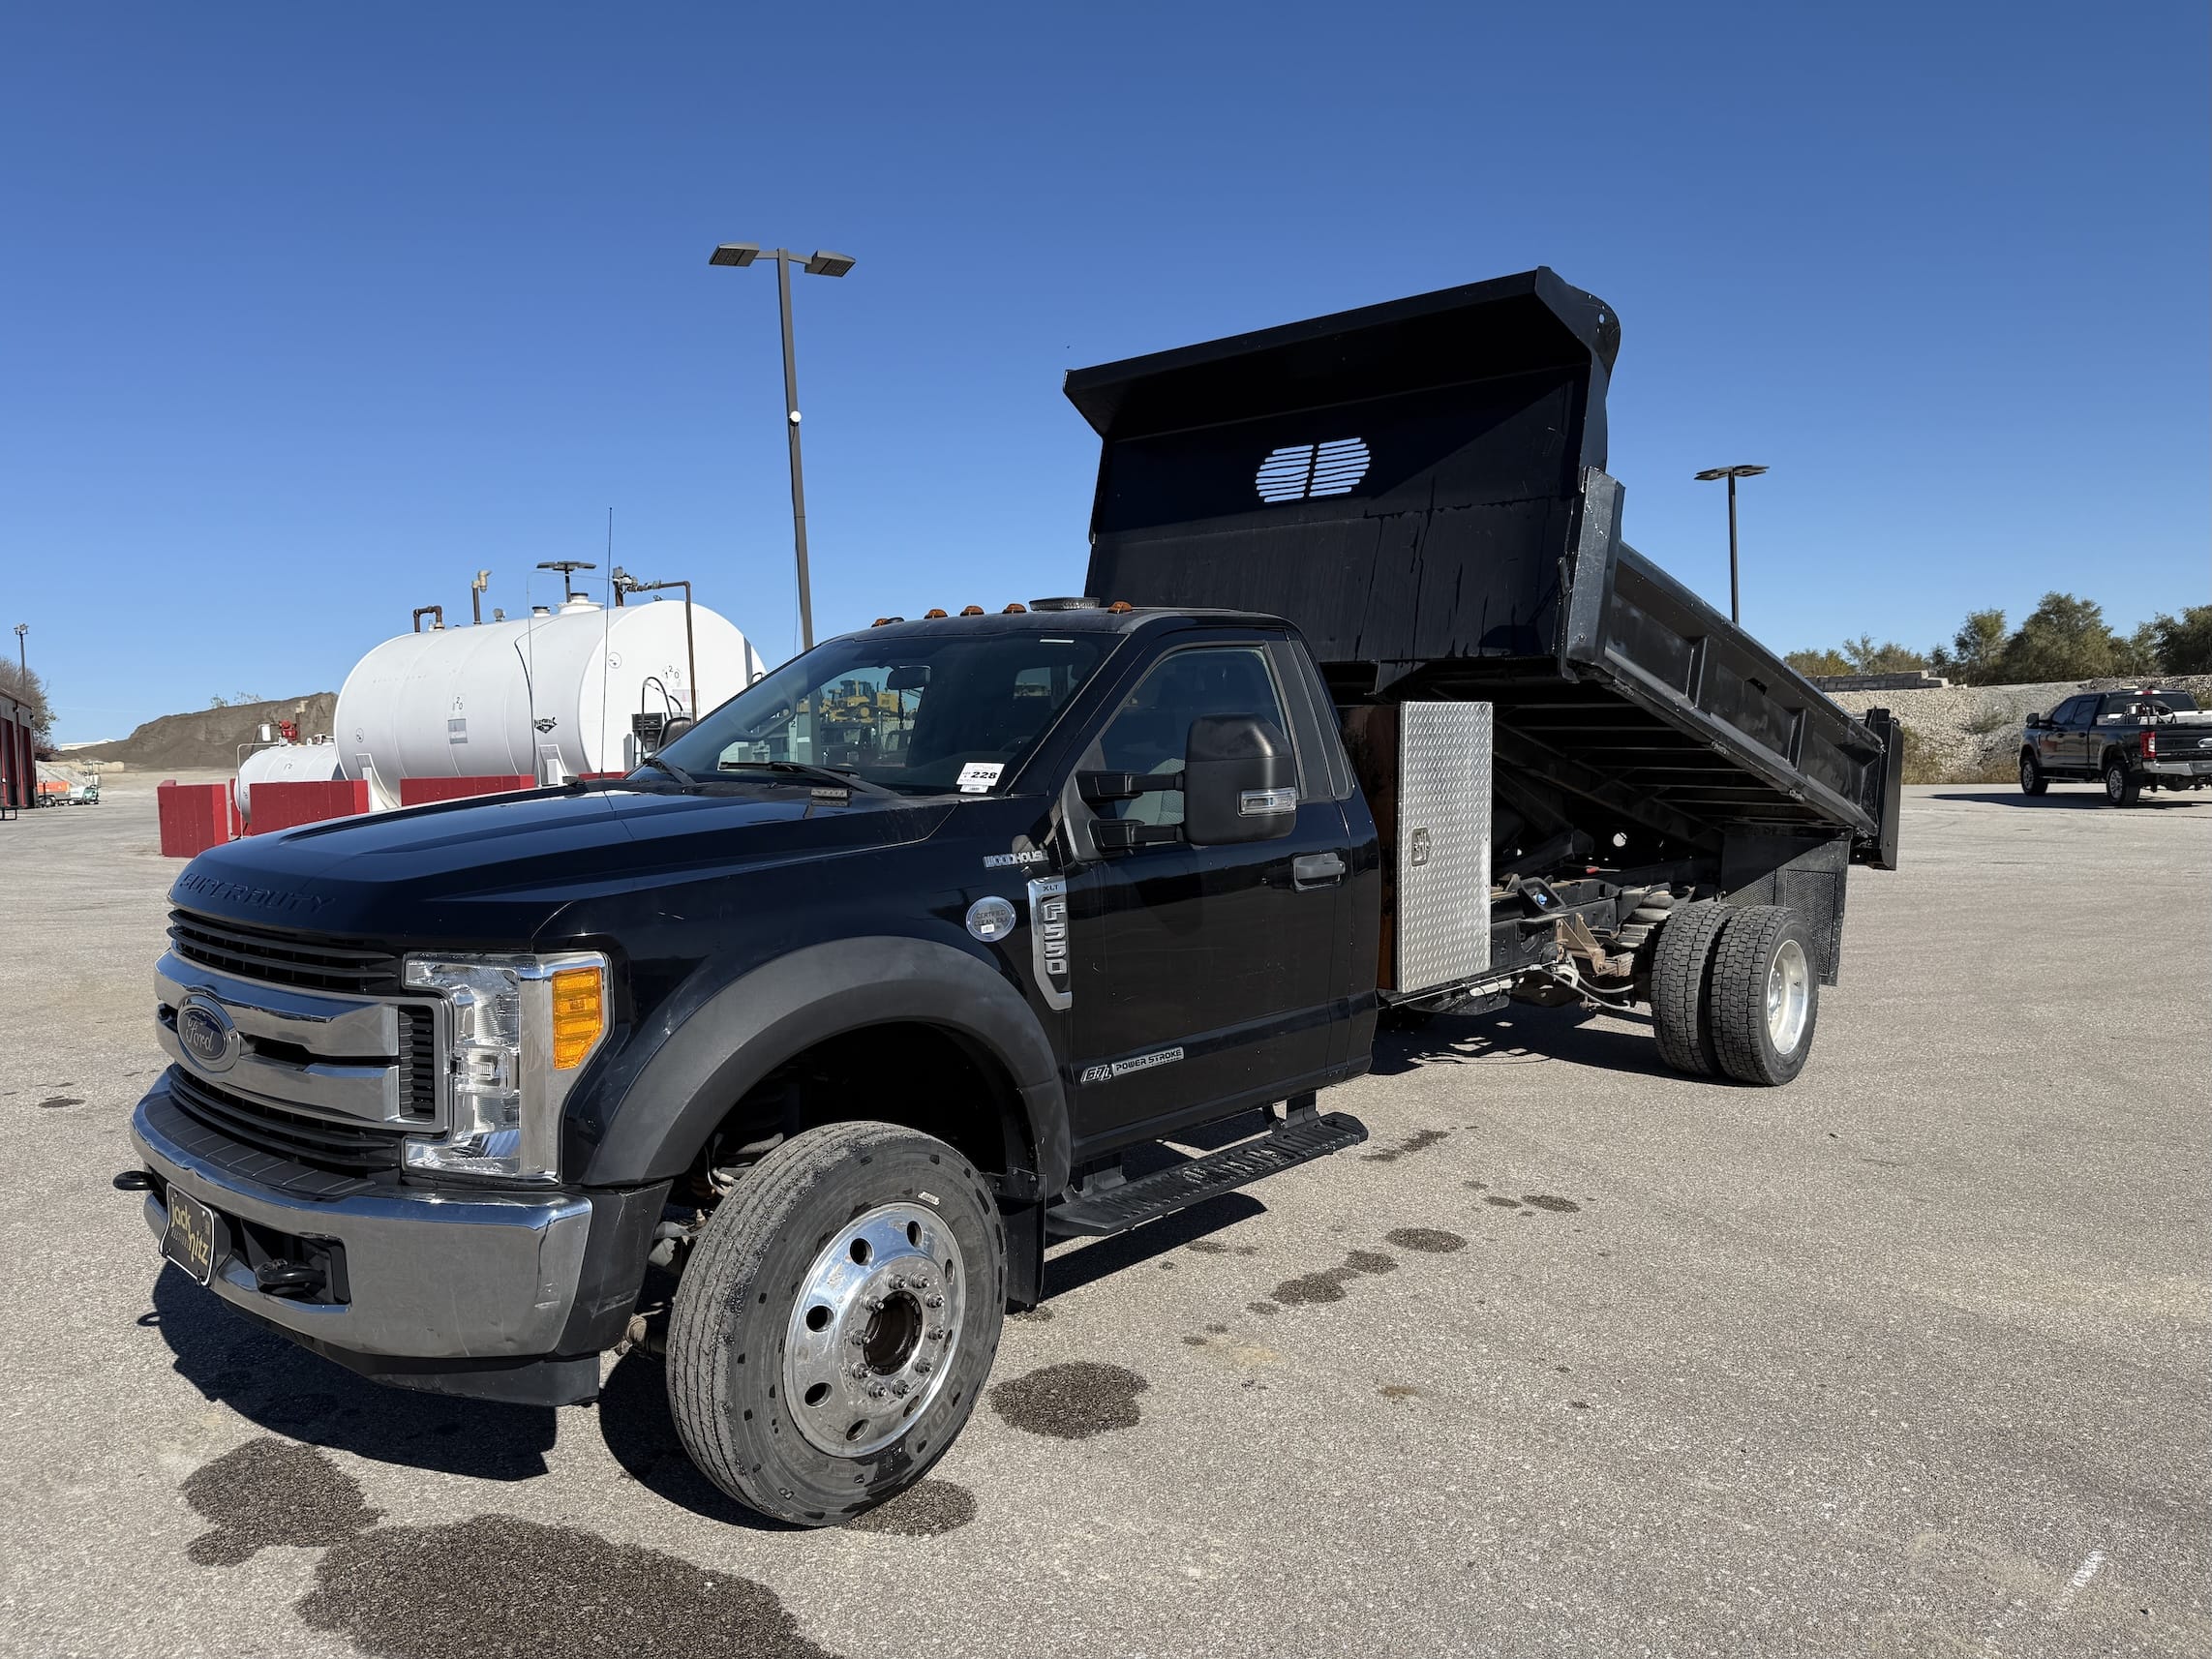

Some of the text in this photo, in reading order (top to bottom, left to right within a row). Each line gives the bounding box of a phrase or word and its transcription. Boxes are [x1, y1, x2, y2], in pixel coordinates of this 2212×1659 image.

[1043, 902, 1068, 976] F550
[185, 1014, 215, 1052] Ford
[1116, 1058, 1147, 1071] POWER
[1148, 1049, 1182, 1064] STROKE
[170, 1196, 192, 1232] jack
